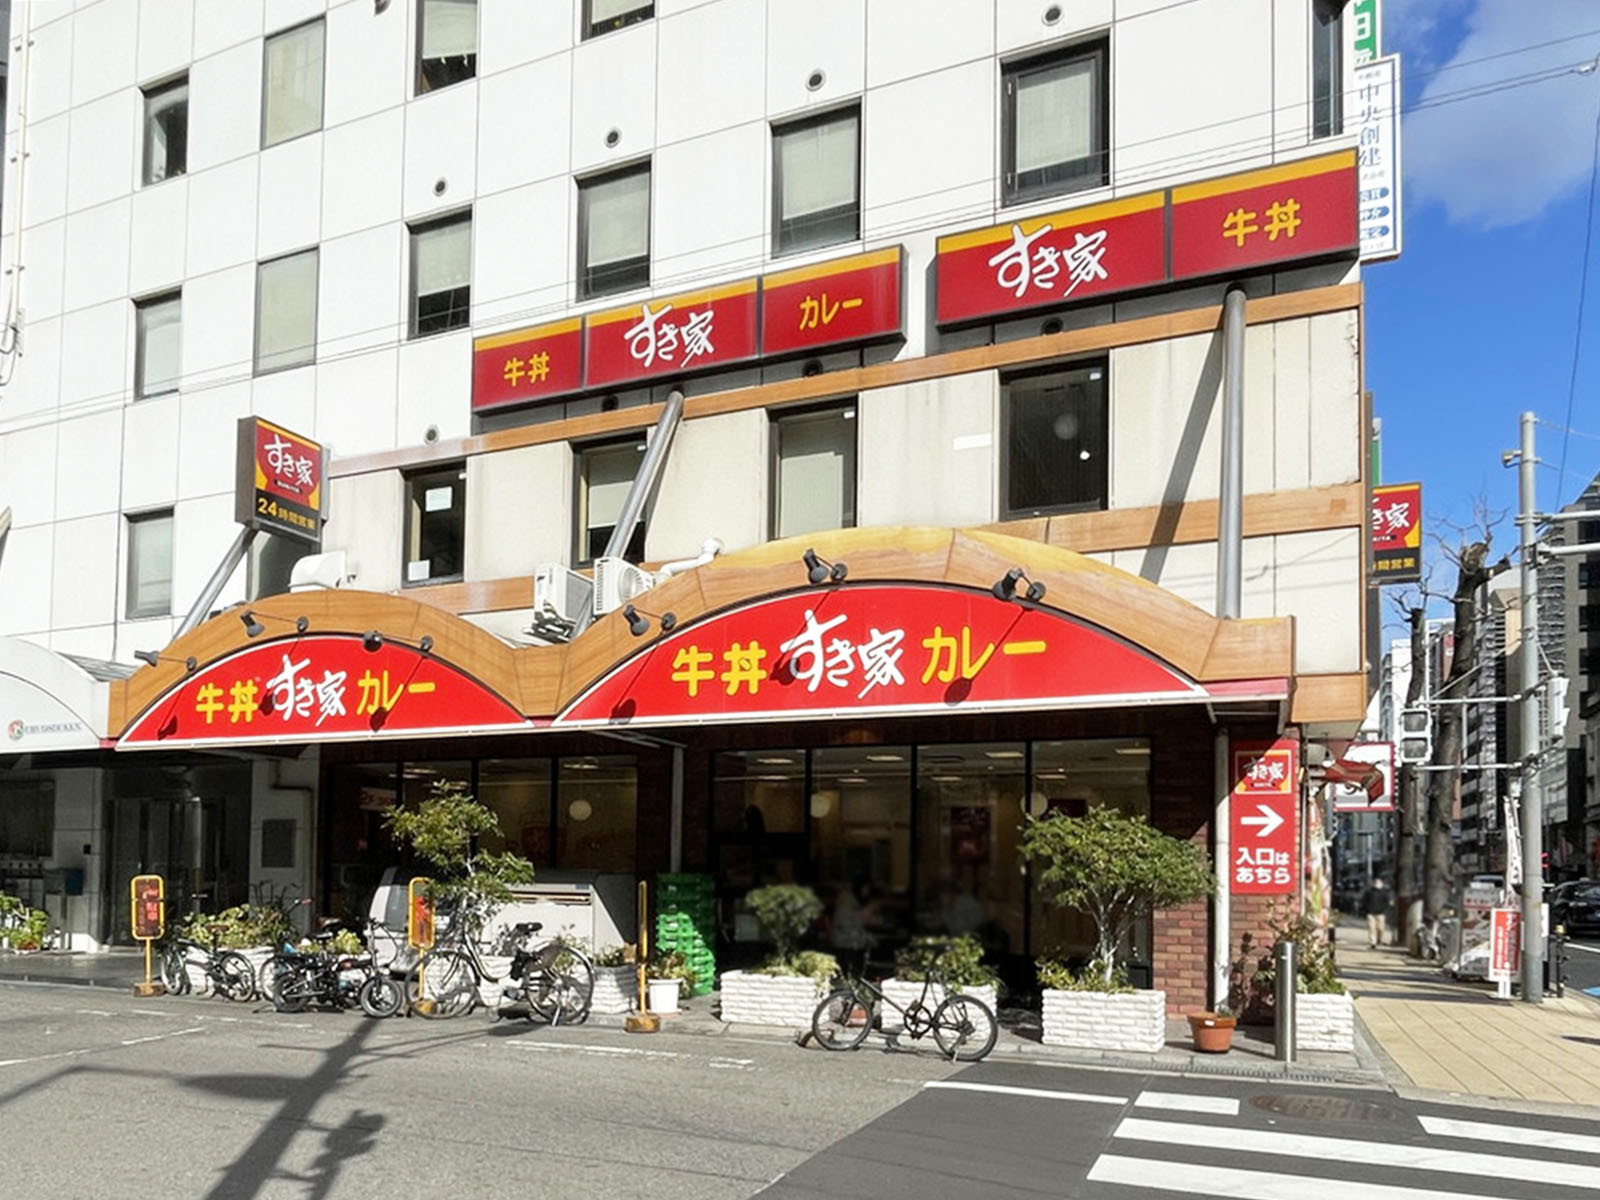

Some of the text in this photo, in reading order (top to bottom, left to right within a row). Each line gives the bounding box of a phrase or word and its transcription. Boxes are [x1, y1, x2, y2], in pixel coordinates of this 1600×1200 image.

[988, 197, 1302, 298] すき家 牛丼
[503, 293, 863, 386] 牛丼 すき家 カレー
[264, 434, 313, 486] すき家
[1373, 497, 1410, 534] き家
[670, 609, 1046, 699] 牛丼 すき家 カレー
[196, 654, 436, 727] 牛丼 すき家 カレー
[1243, 757, 1284, 784] すき家
[1235, 867, 1291, 884] あちら
[1236, 847, 1290, 865] 入口は
